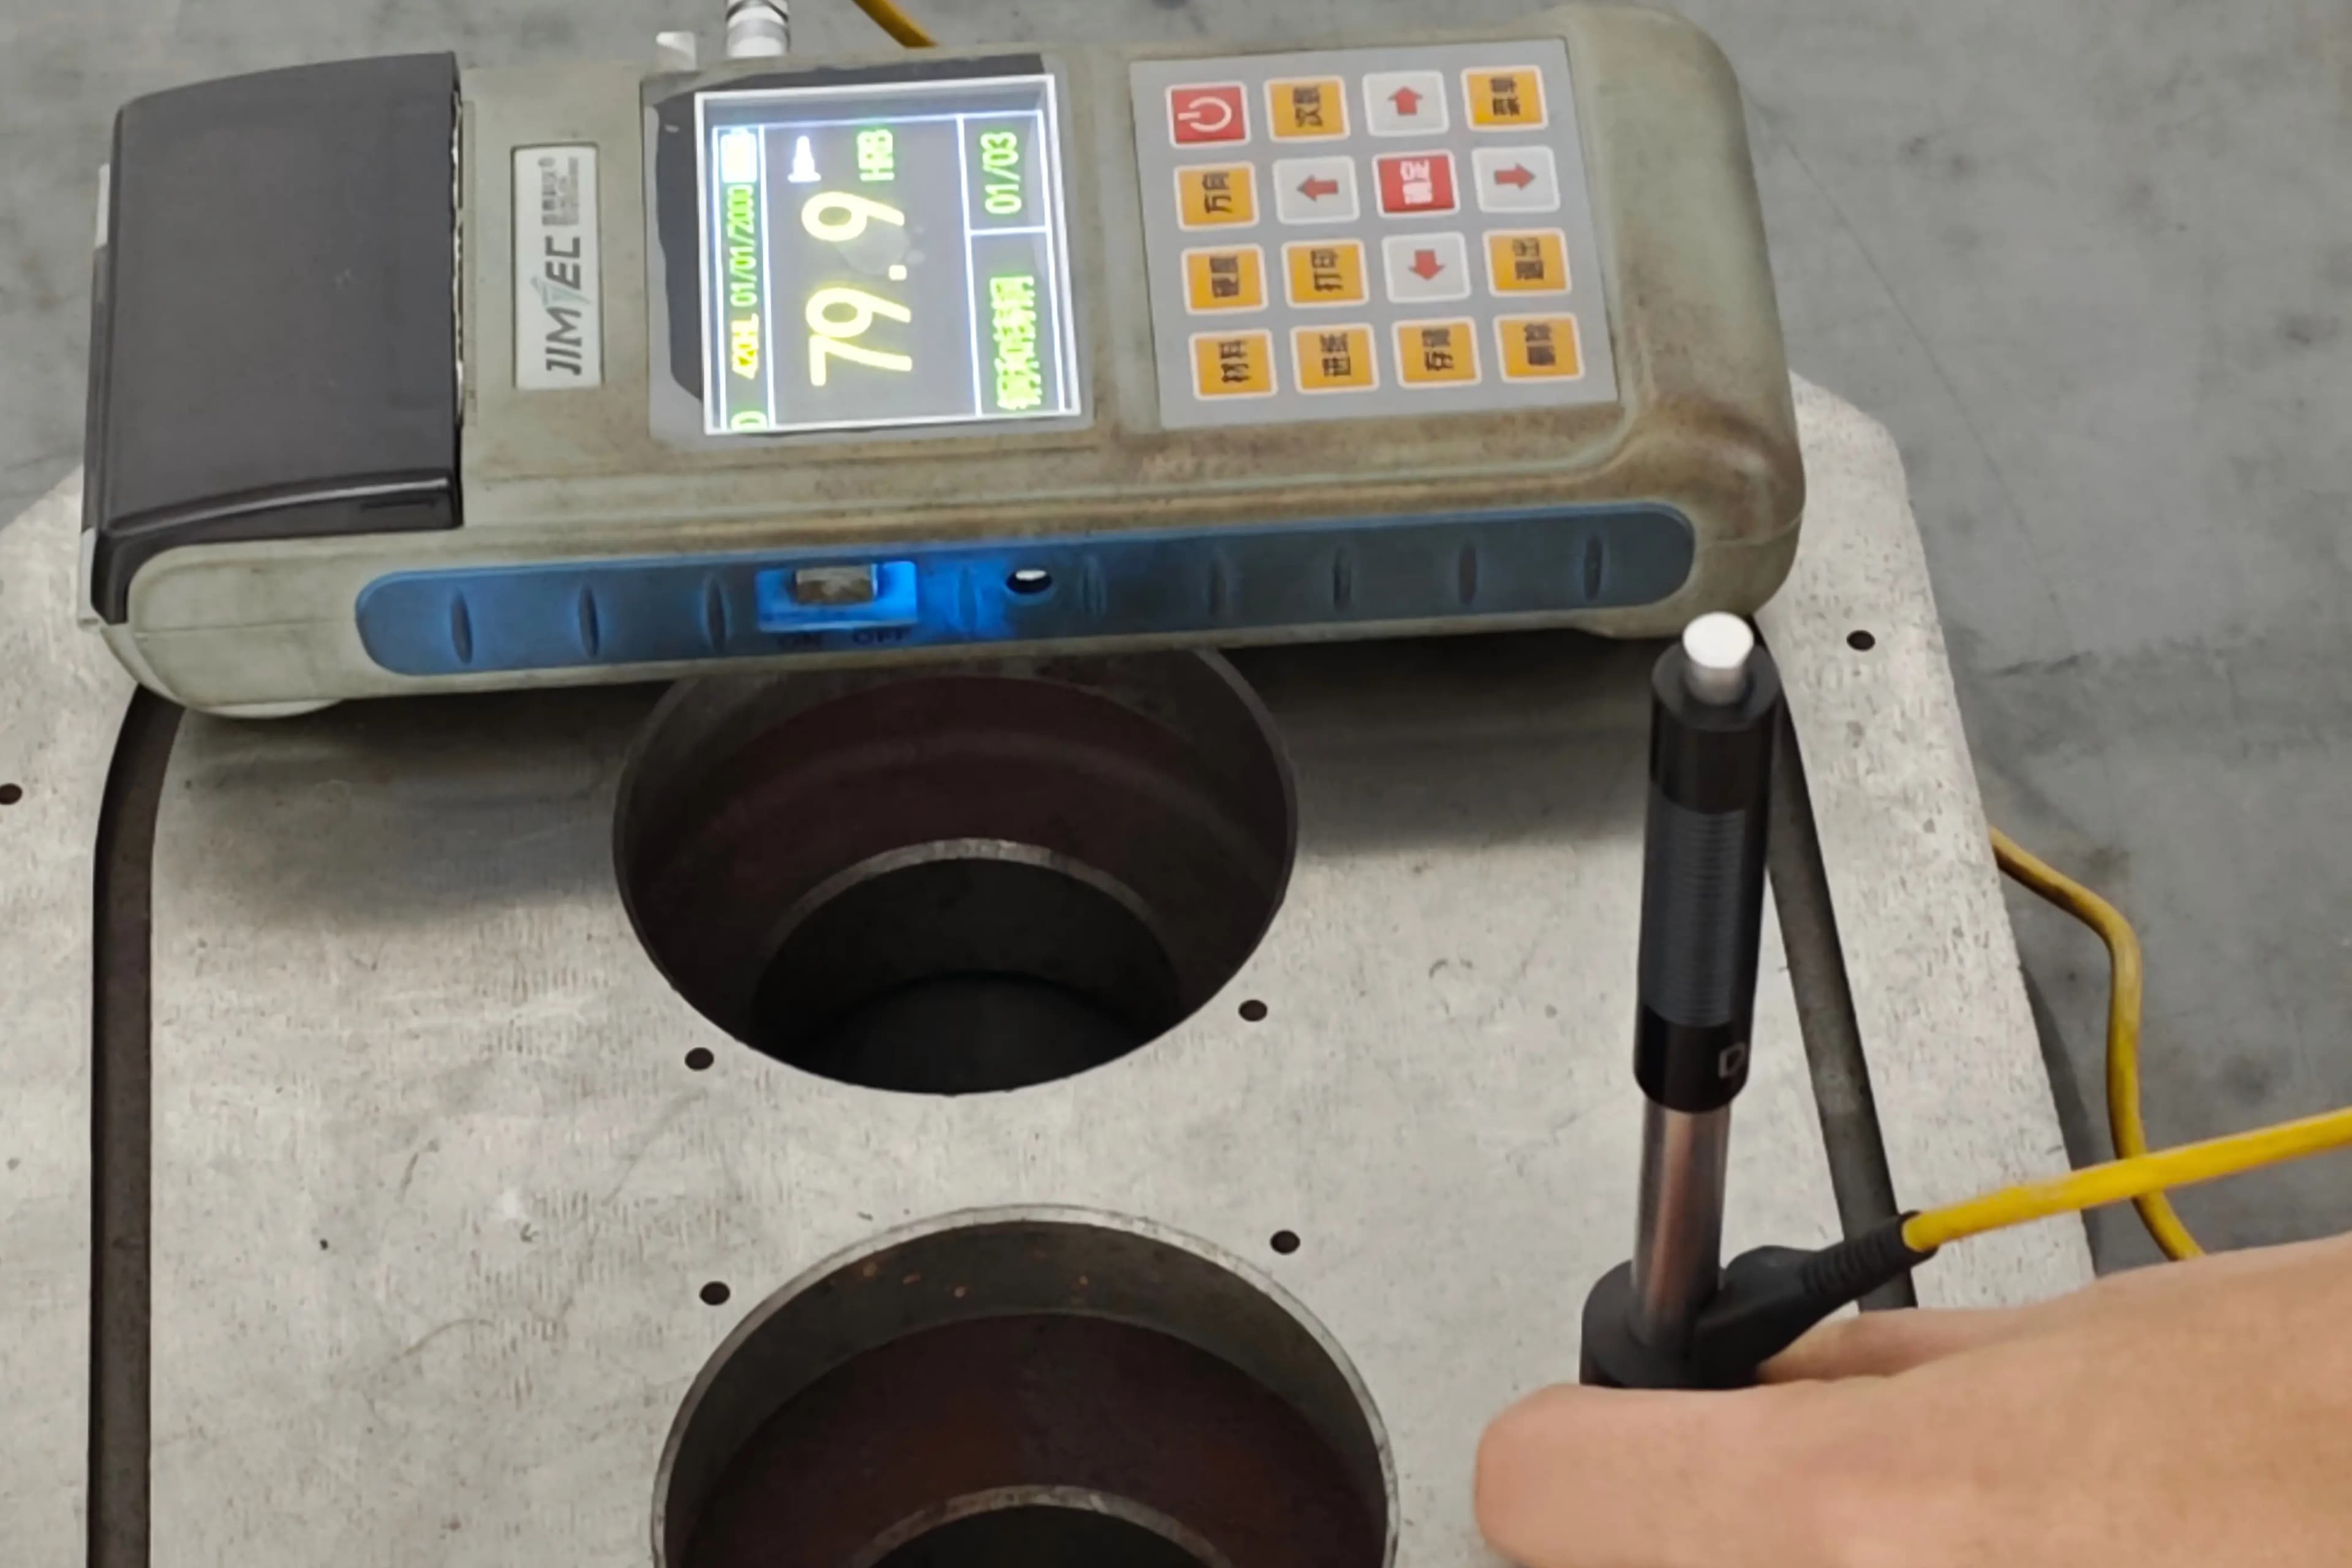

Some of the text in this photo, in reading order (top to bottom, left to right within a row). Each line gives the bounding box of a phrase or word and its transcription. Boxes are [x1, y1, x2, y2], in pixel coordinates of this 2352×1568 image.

[857, 129, 895, 181] HRB
[980, 132, 1022, 214] 01/03
[1202, 172, 1232, 214] 方向
[1400, 160, 1433, 205] 确定
[801, 191, 912, 386] 79.9
[1310, 249, 1343, 292] 打印
[1217, 339, 1251, 383] 材料
[1420, 328, 1455, 371] 存储
[851, 627, 911, 644] OFF
